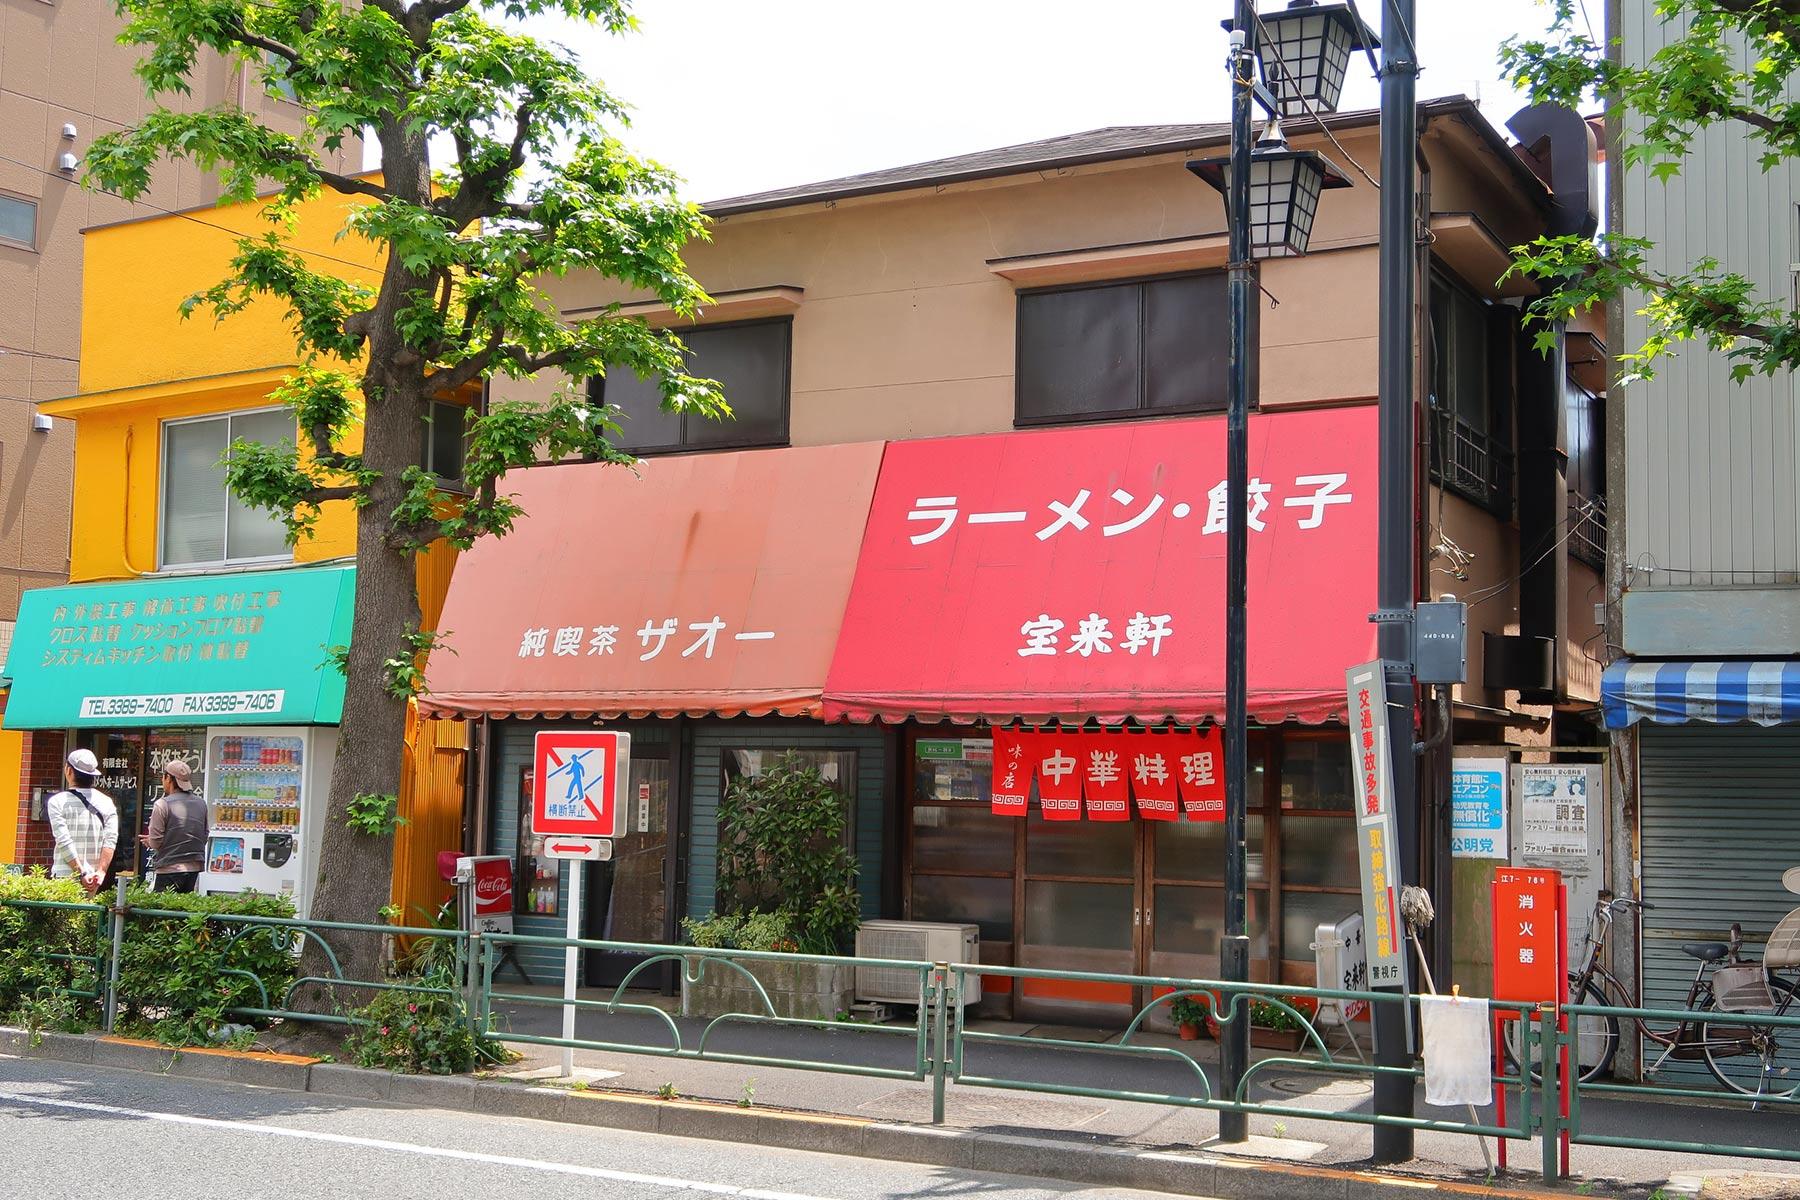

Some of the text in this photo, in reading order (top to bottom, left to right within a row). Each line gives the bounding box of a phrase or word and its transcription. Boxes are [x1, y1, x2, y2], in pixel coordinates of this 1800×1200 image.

[906, 473, 1353, 546] ラーメン・餃子
[518, 616, 776, 661] 純喫茶 ザオー
[1016, 612, 1173, 657] 宝来軒
[102, 757, 128, 769] 有限会社
[1001, 744, 1022, 789] 味の店
[1041, 748, 1216, 788] 中華料理
[1358, 688, 1379, 815] 交通事故多発
[1452, 784, 1489, 794] エアコン
[548, 803, 587, 818] 横断禁止
[1556, 804, 1585, 821] 調査
[1451, 838, 1494, 852] 公明党
[1369, 829, 1391, 959] 取締強化路線
[1518, 894, 1534, 963] 消火器
[1372, 965, 1398, 980] 警視庁
